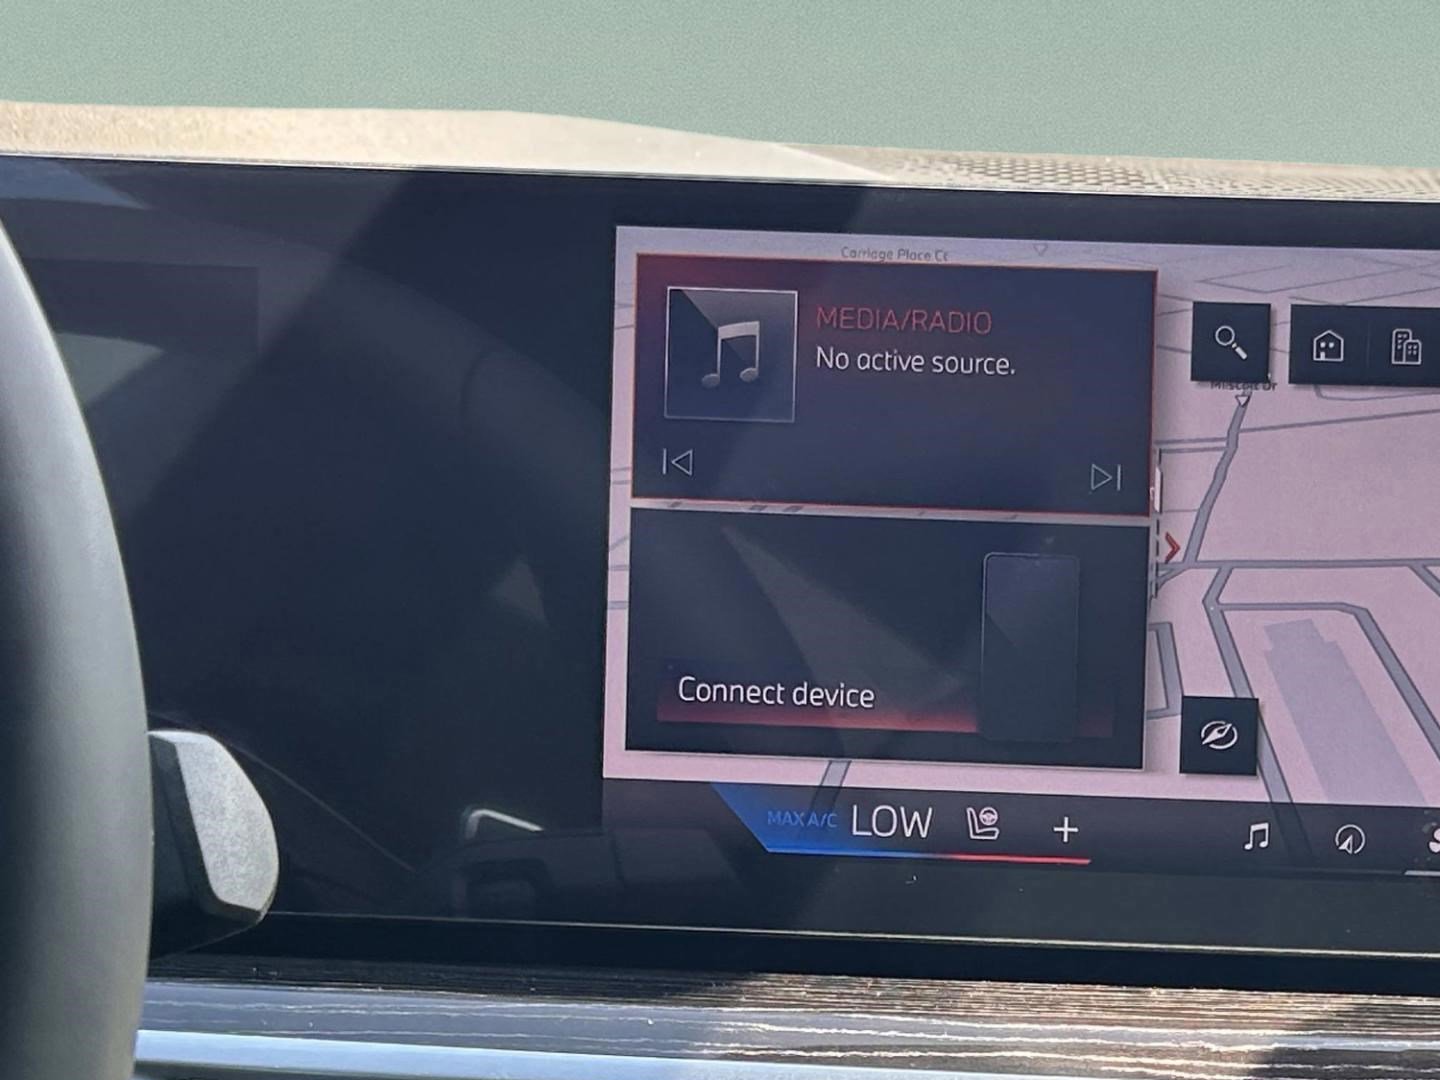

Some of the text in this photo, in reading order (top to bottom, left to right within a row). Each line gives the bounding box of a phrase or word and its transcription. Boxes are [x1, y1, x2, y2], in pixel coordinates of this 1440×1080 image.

[897, 248, 931, 261] Place
[816, 306, 993, 335] MEDIA/RADIO
[816, 345, 1016, 376] No active source.
[678, 675, 876, 709] Connect device
[767, 809, 838, 829] MAX A/C
[851, 804, 933, 839] LOW
